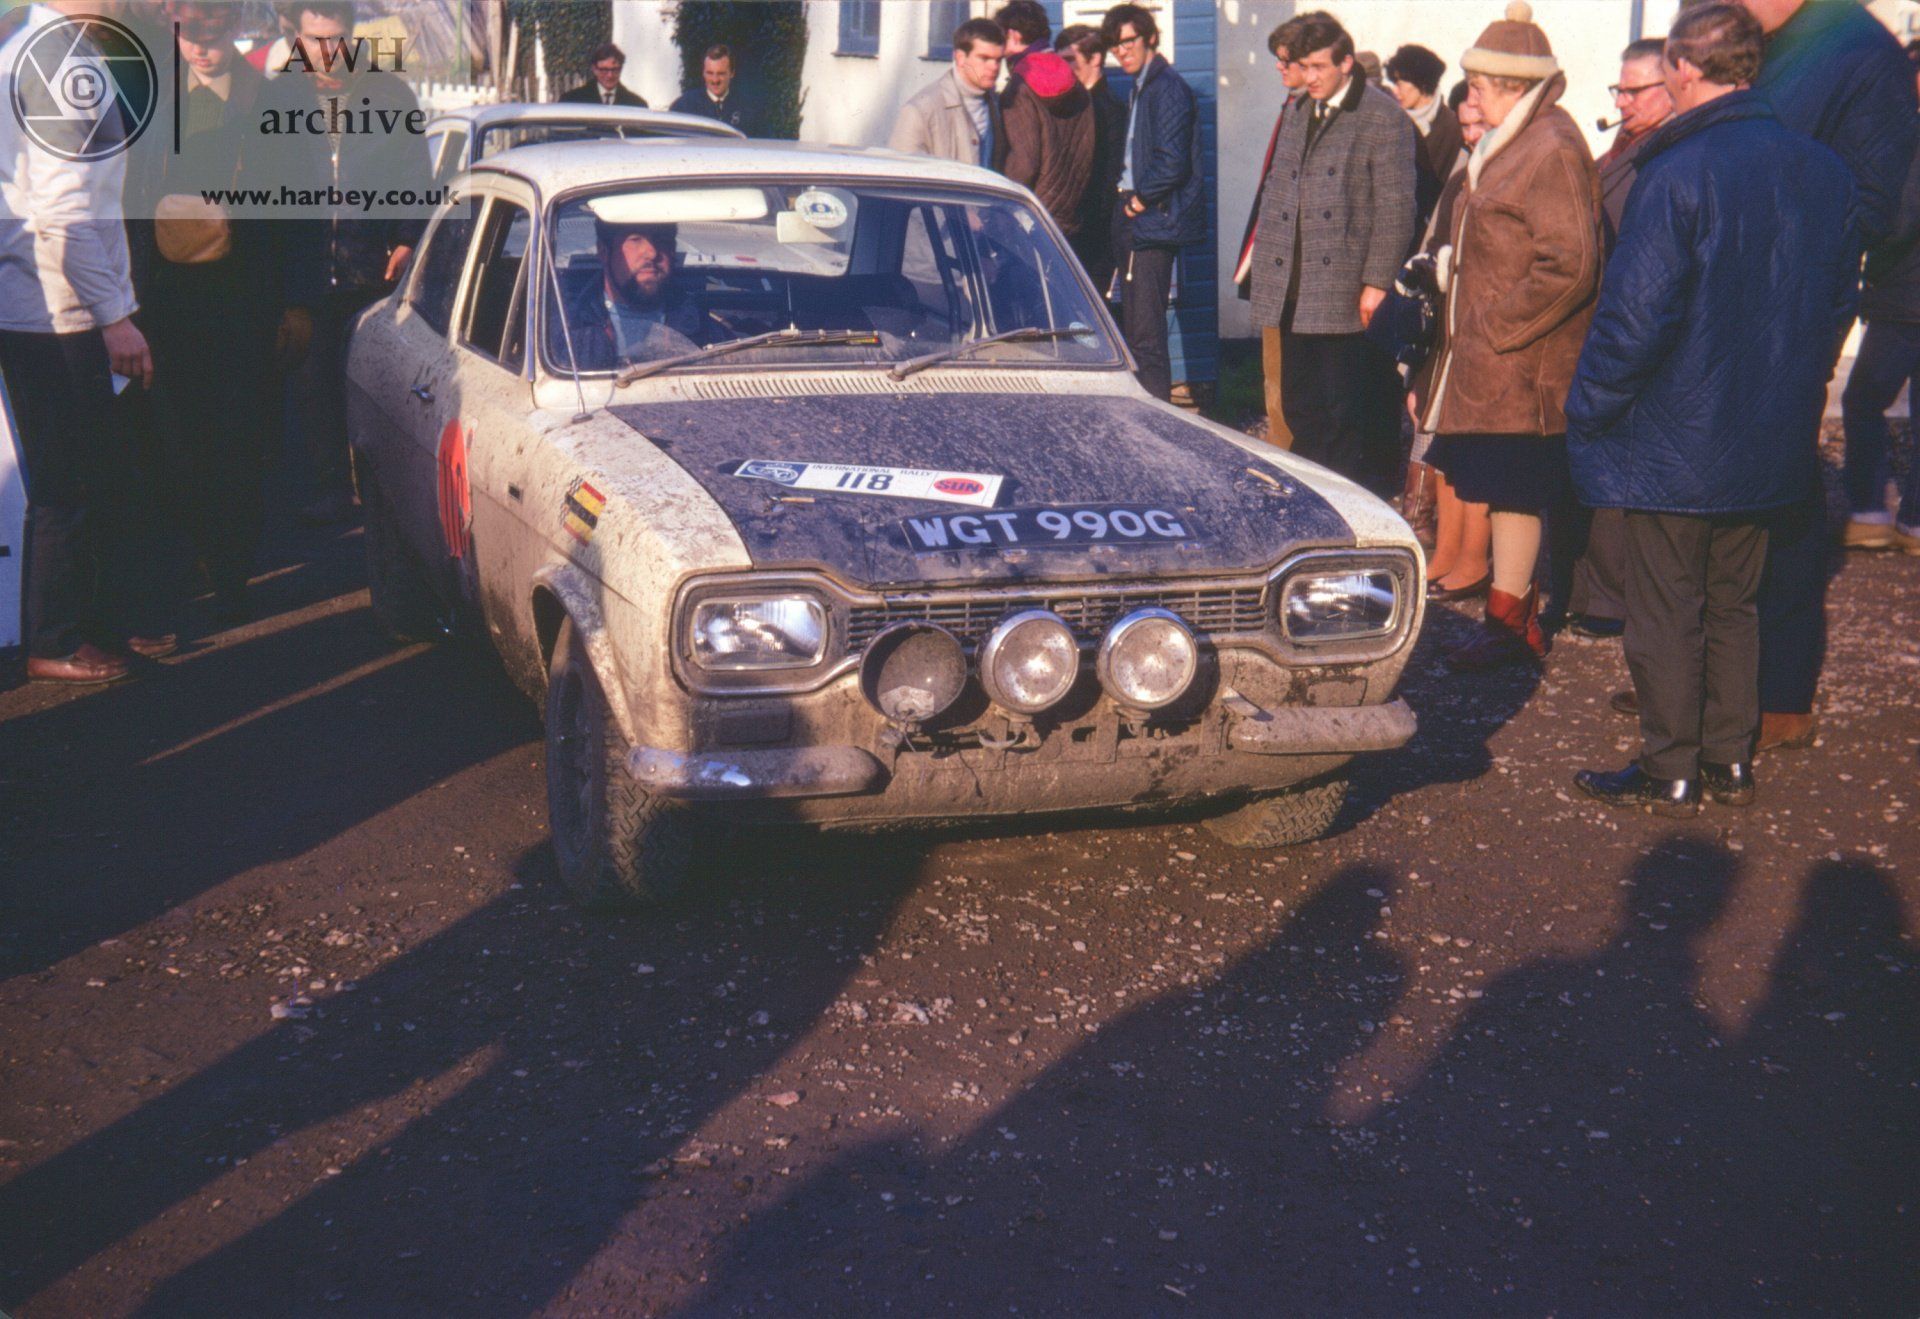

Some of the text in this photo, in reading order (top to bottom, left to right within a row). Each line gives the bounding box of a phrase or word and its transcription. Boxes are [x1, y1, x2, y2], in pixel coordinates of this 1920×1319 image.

[811, 463, 933, 477] INTERNATIONAL RALLY
[836, 471, 894, 491] 118
[937, 479, 980, 493] SUN
[908, 509, 1186, 547] WGT 990G
